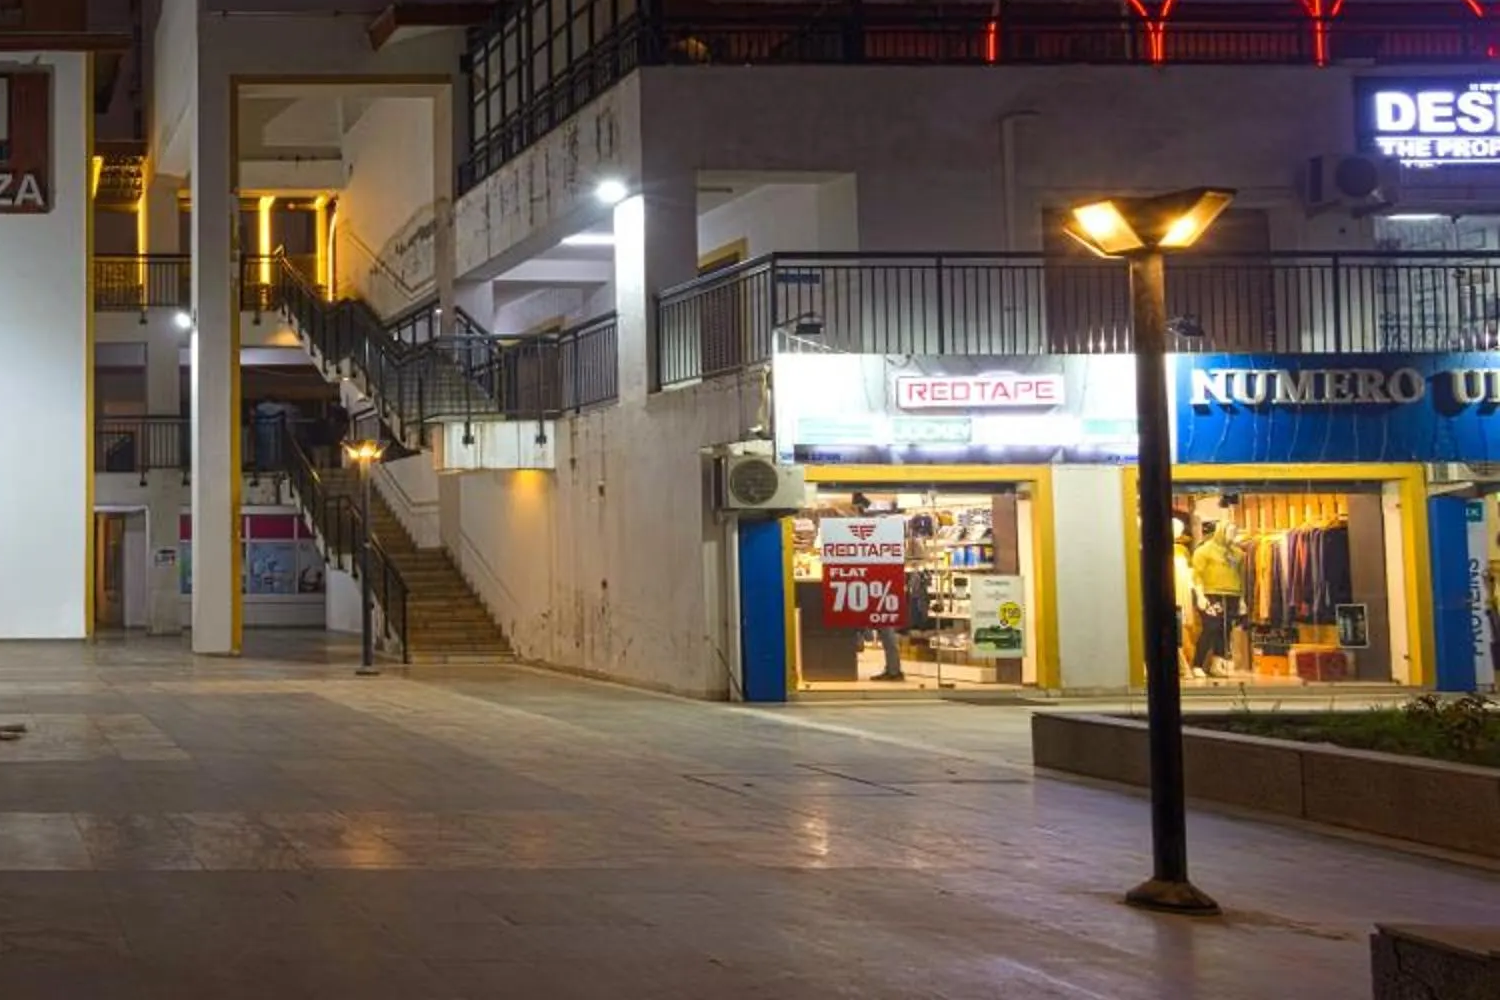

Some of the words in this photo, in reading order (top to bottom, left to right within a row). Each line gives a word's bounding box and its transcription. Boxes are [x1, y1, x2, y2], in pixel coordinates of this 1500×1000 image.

[1375, 91, 1500, 133] DES
[1376, 138, 1433, 156] THE
[908, 380, 1055, 400] REDTAPE
[1192, 368, 1425, 405] NUMERO
[824, 543, 902, 557] REDTAPE
[830, 567, 867, 577] FLAT
[830, 580, 899, 612] 70%
[870, 613, 899, 623] OFF
